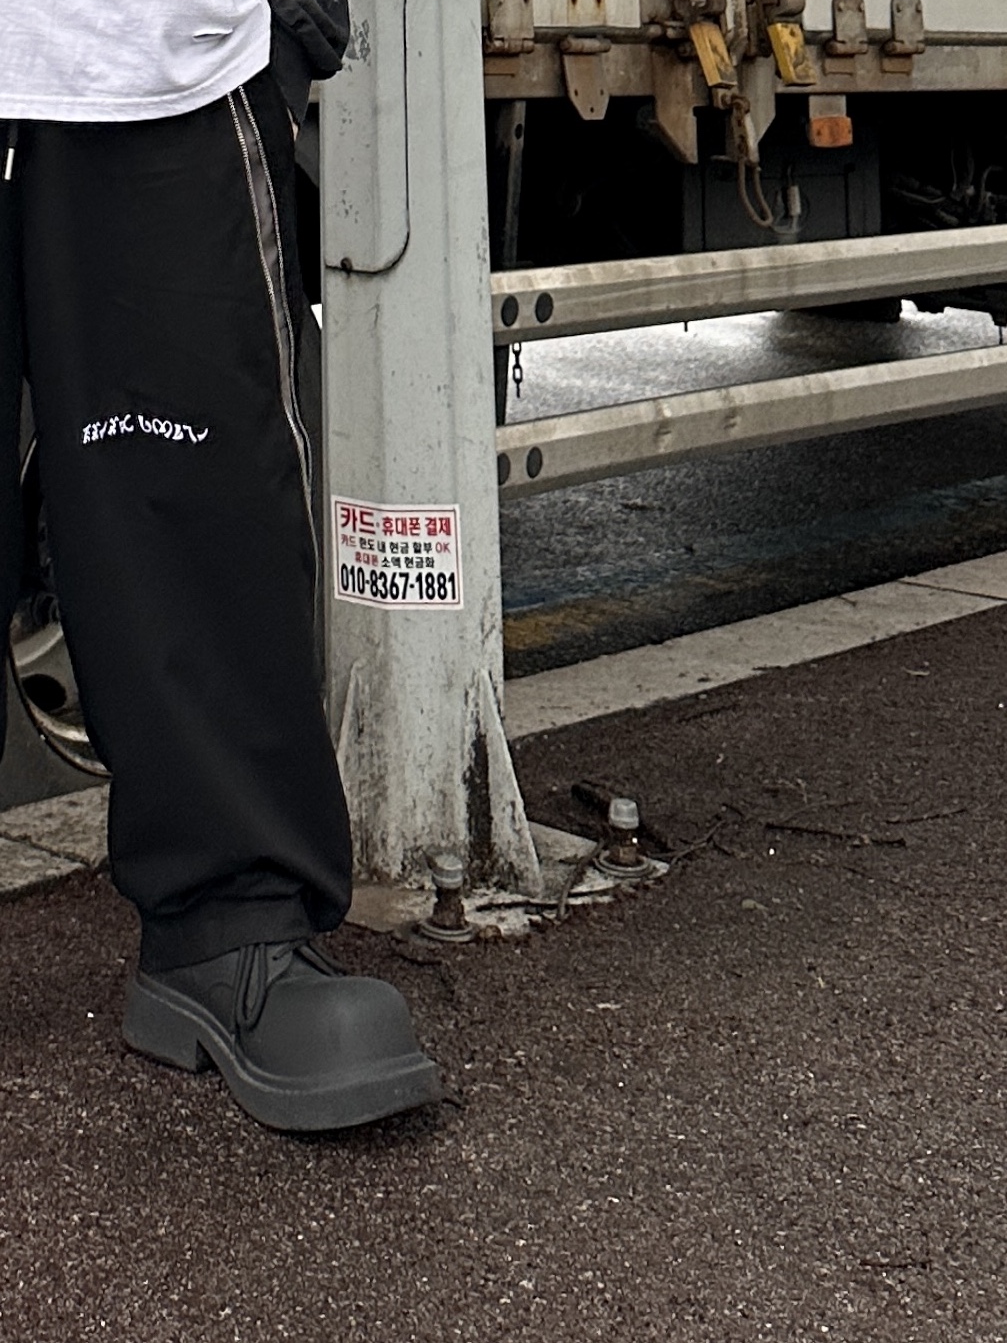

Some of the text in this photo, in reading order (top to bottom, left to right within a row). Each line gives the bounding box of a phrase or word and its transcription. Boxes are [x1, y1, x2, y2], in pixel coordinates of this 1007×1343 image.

[424, 517, 452, 536] 결제
[341, 534, 357, 547] 카드
[435, 542, 452, 554] OK
[340, 563, 457, 600] 010-8367-1881
